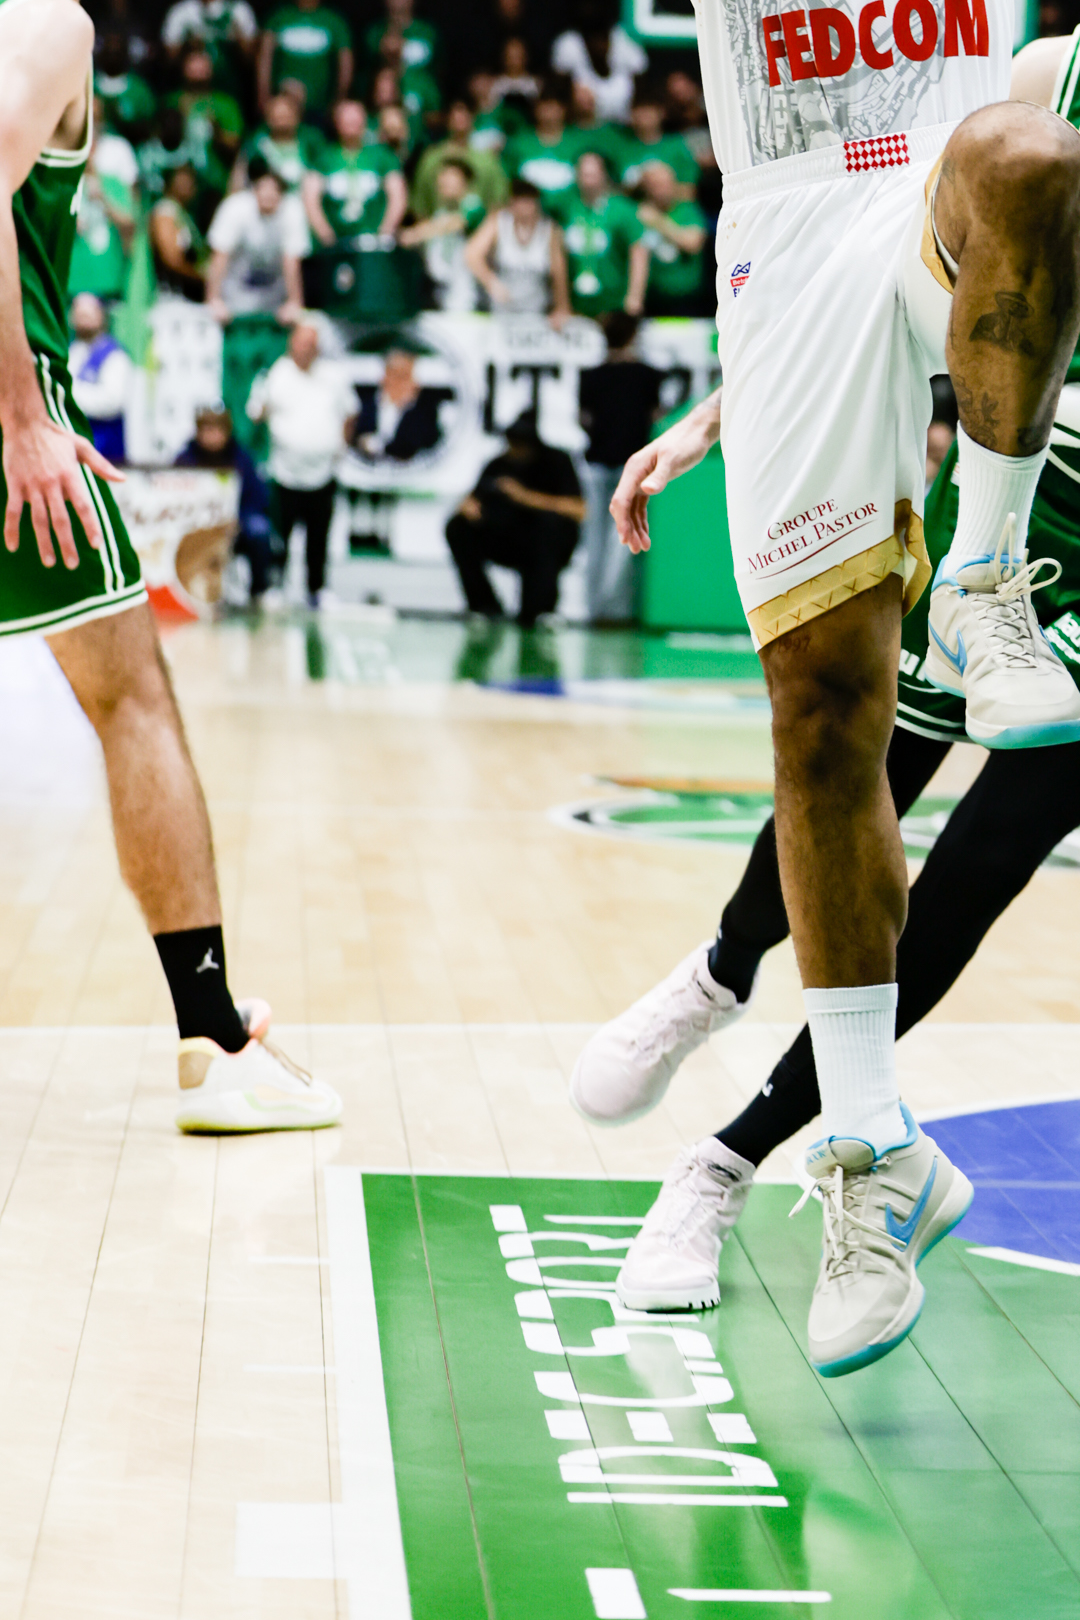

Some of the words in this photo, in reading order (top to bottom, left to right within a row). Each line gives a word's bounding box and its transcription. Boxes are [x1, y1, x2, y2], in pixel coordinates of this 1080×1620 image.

[747, 531, 813, 575] MICHEL
[812, 501, 879, 541] PASTOR
[767, 498, 838, 540] GROUPE
